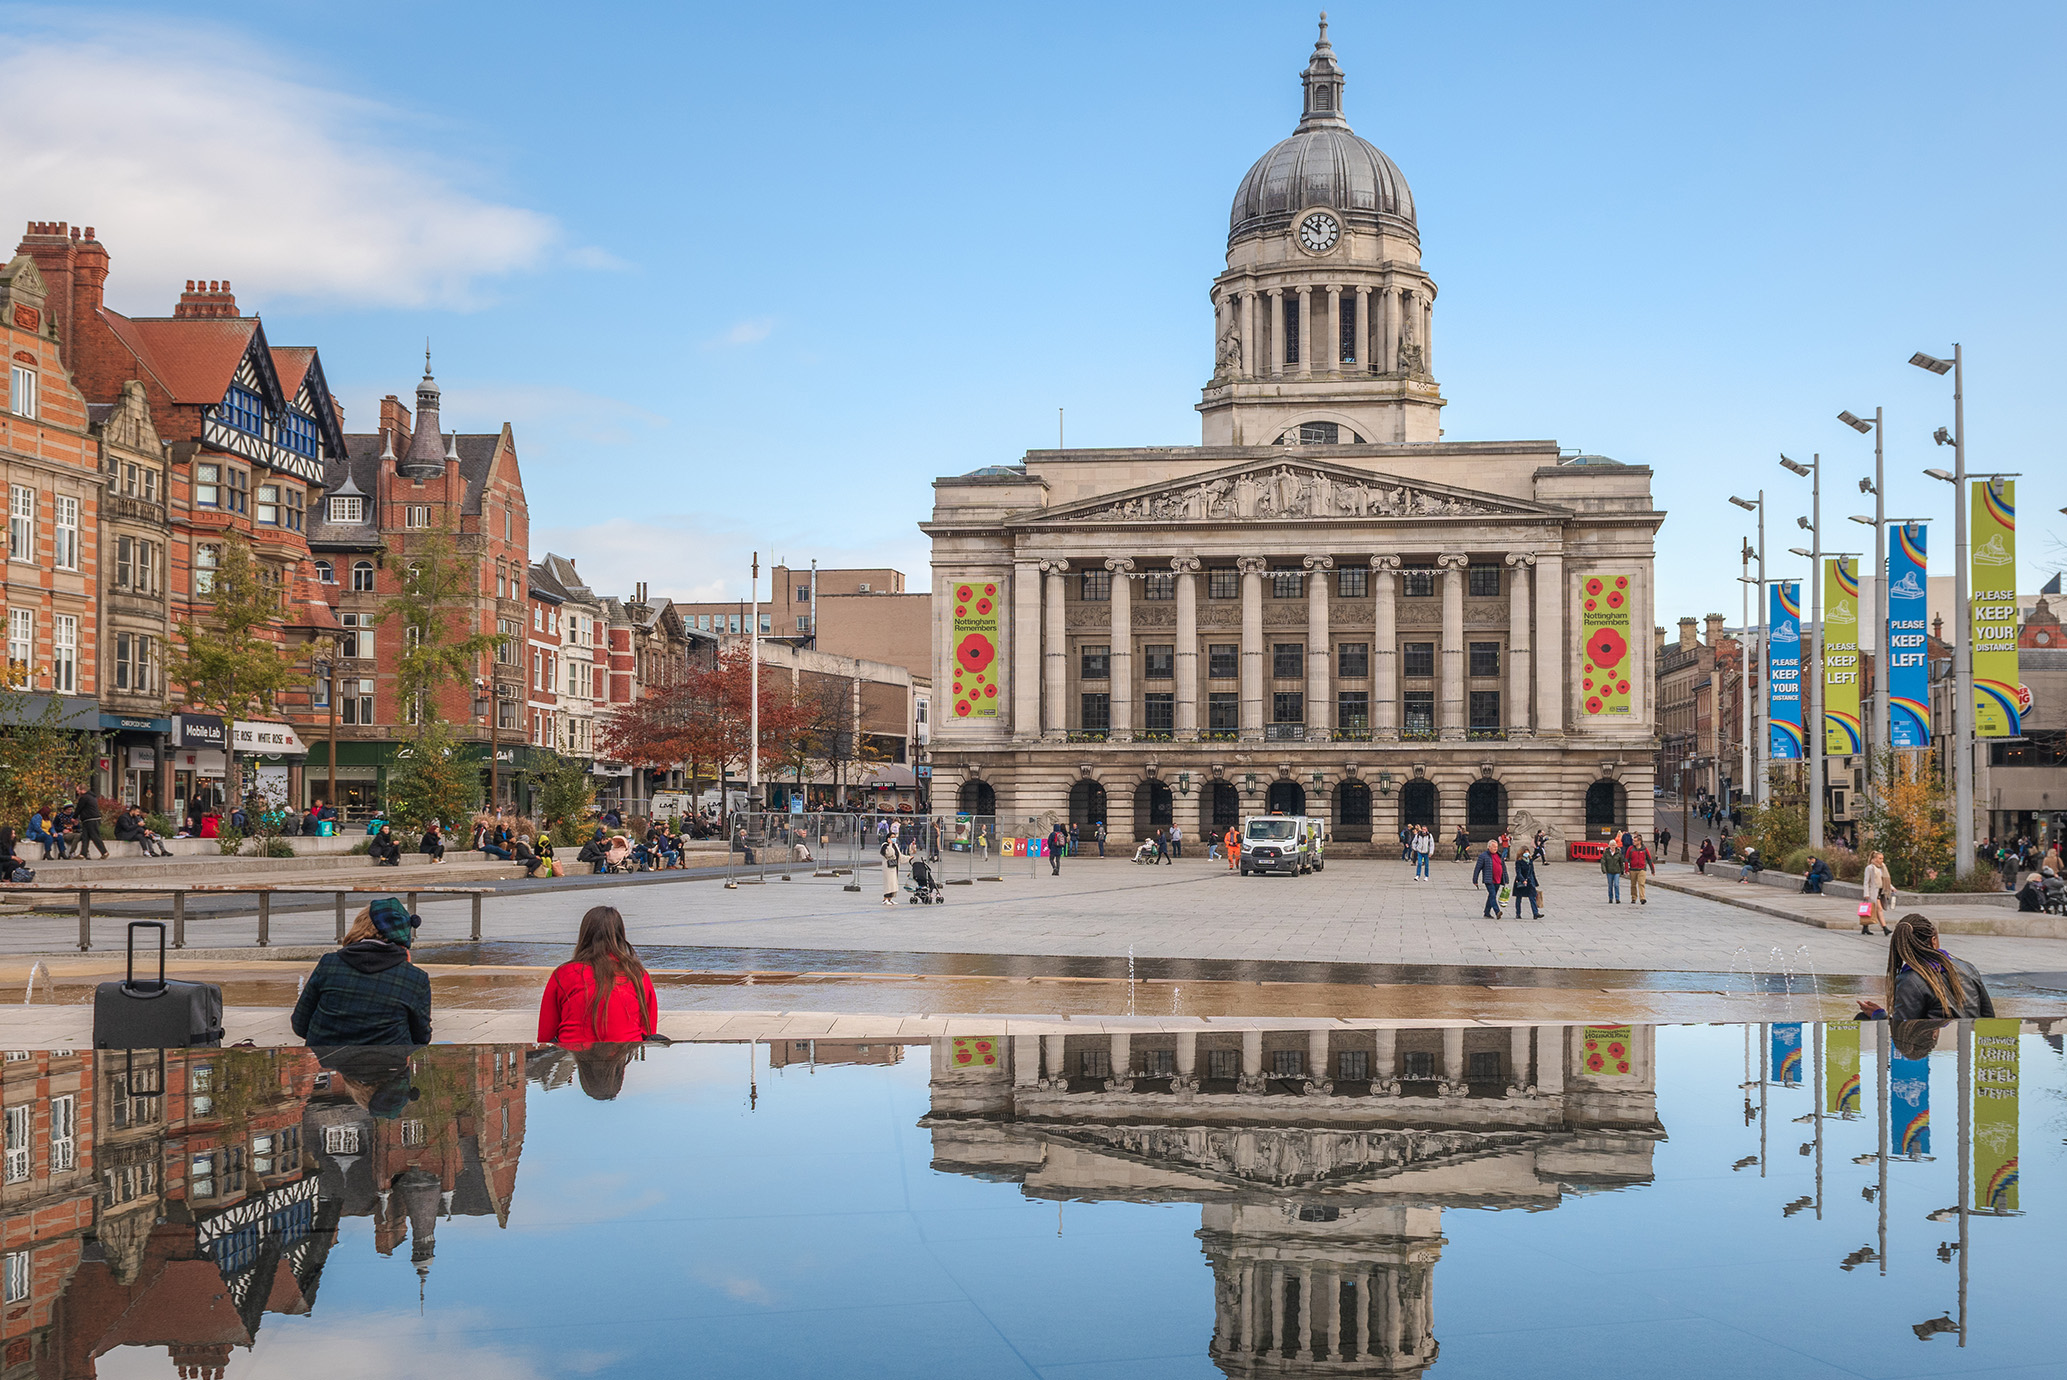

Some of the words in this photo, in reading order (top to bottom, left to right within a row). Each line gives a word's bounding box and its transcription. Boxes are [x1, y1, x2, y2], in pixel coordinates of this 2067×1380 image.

[1975, 590, 2014, 601] PLEASE
[1584, 612, 1628, 620] Nottingham
[1975, 606, 2015, 621] KEEP
[954, 618, 996, 626] Nottingham
[1891, 620, 1925, 629] PLEASE
[1975, 625, 2015, 640] YOUR
[1826, 643, 1857, 651] PLEASE
[1891, 635, 1926, 648] KEEP
[1976, 643, 2015, 652] DISTANCE
[1827, 656, 1857, 667] KEEP
[1892, 653, 1926, 667] LEFT
[1772, 669, 1799, 680] KEEP
[1827, 672, 1858, 684] LEFT
[1772, 683, 1799, 693] YOUR
[186, 724, 208, 738] Mobile
[208, 726, 221, 738] Lab
[257, 732, 271, 744] WHITE
[272, 734, 284, 744] ROSE
